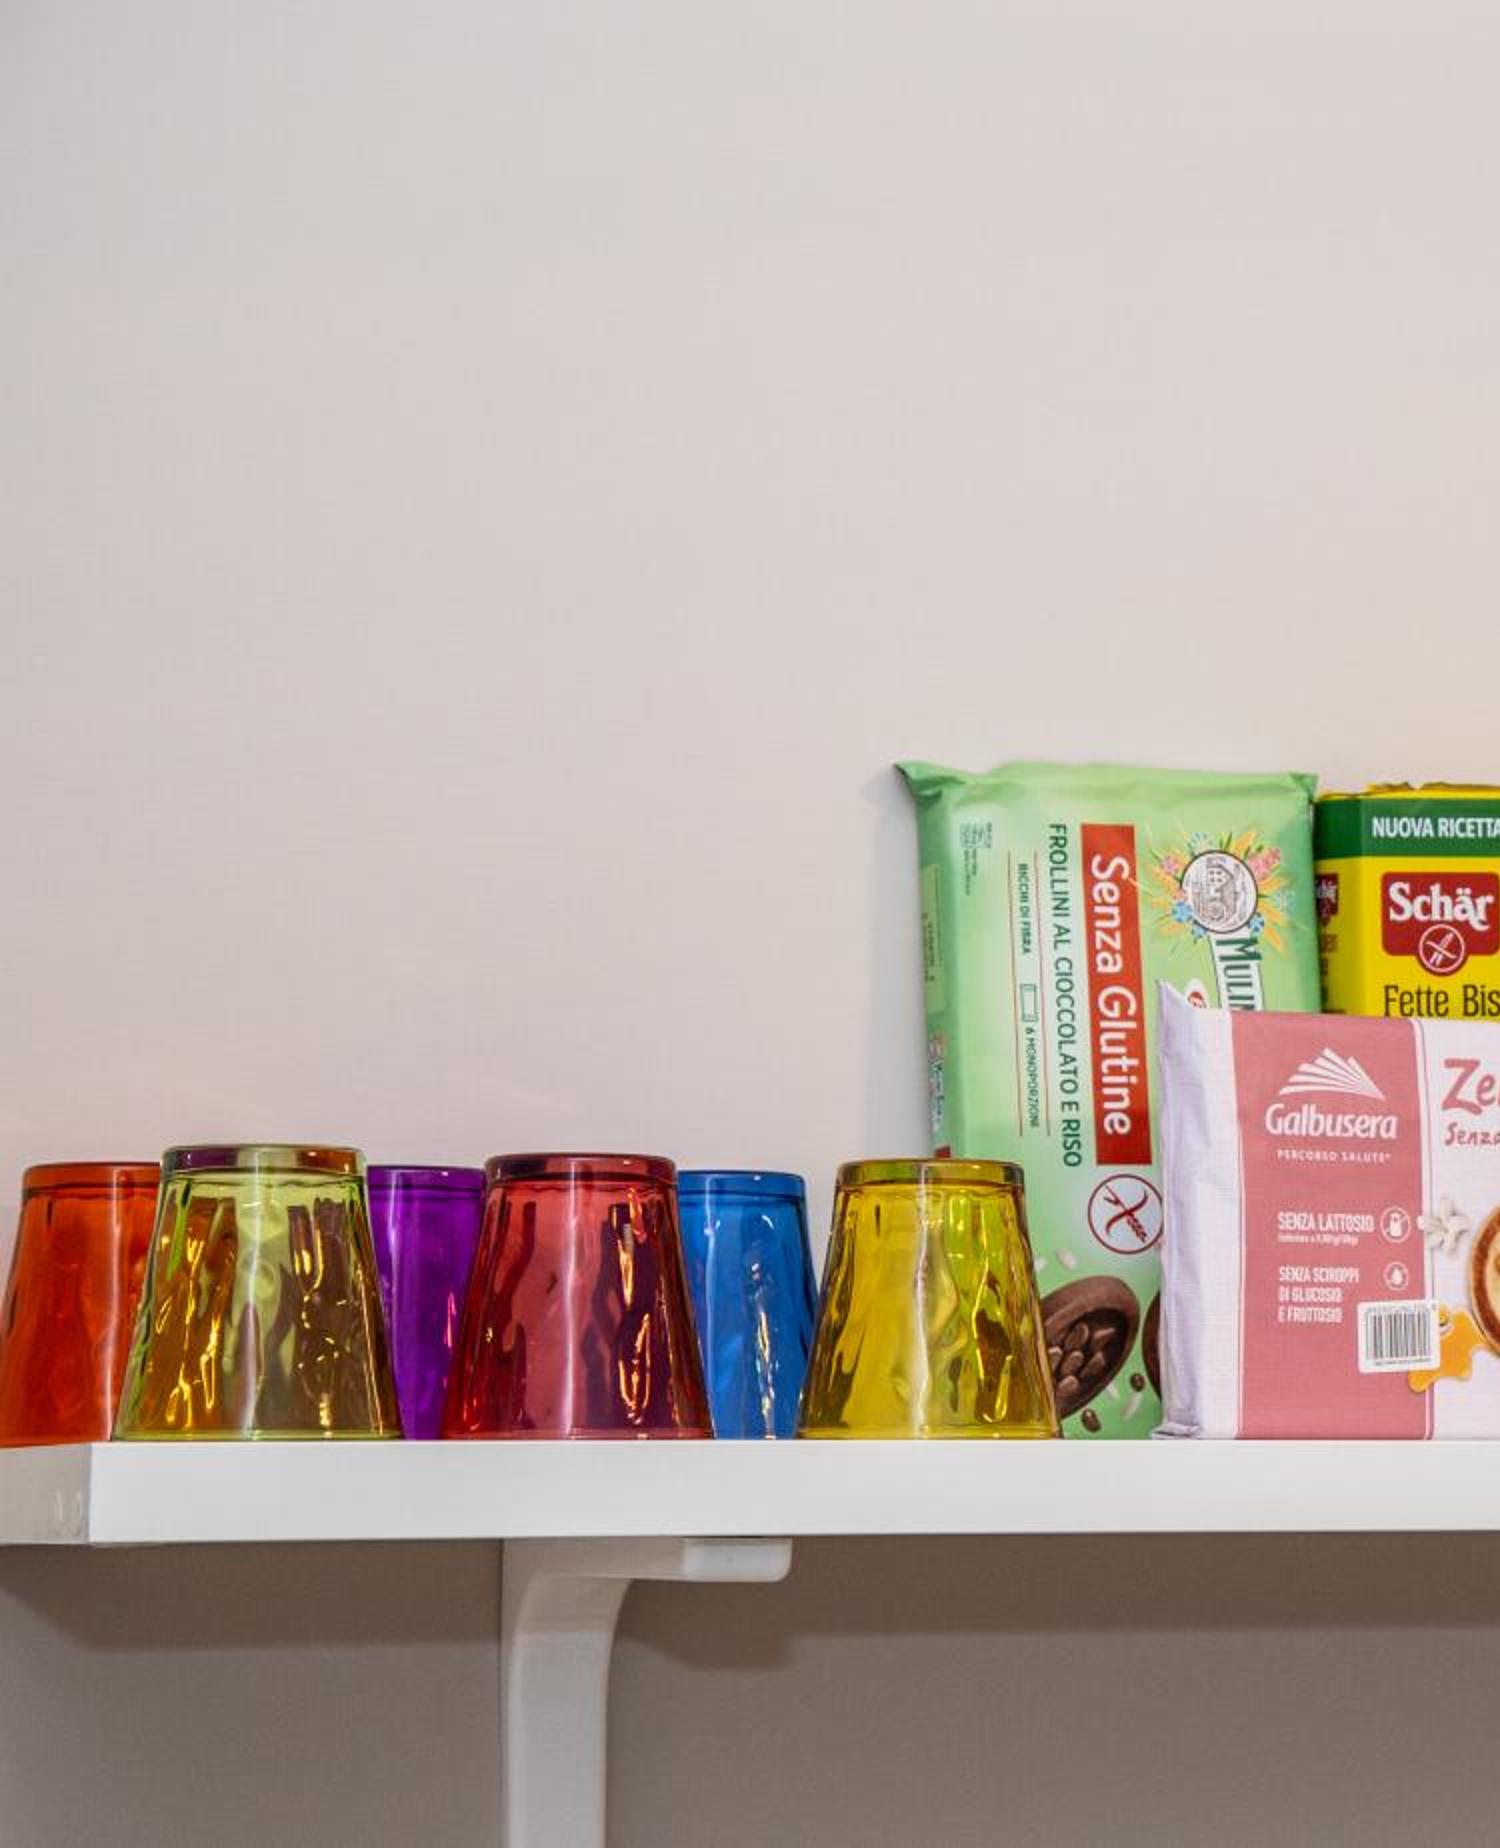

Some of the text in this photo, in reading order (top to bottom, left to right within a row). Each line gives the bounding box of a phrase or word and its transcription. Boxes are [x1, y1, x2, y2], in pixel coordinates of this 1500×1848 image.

[1371, 816, 1434, 839] NUOVA
[1017, 863, 1032, 955] RICCHI DI FIBRA
[1387, 880, 1496, 931] Schär
[1049, 823, 1083, 1168] FROLLINI AL CIOCCOLATO E RISO
[1090, 854, 1139, 1137] Senza Glutine
[1383, 984, 1450, 1018] Fette
[1264, 1103, 1398, 1140] Galbusera
[1277, 1148, 1338, 1162] PERCORSO
[1277, 1211, 1376, 1233] SENZA LATTOSIO
[1278, 1266, 1360, 1284] SENZA SCIROPPI
[1278, 1286, 1344, 1303] DI GLUCOSIO
[1287, 1307, 1344, 1324] FRUTTOSIO
